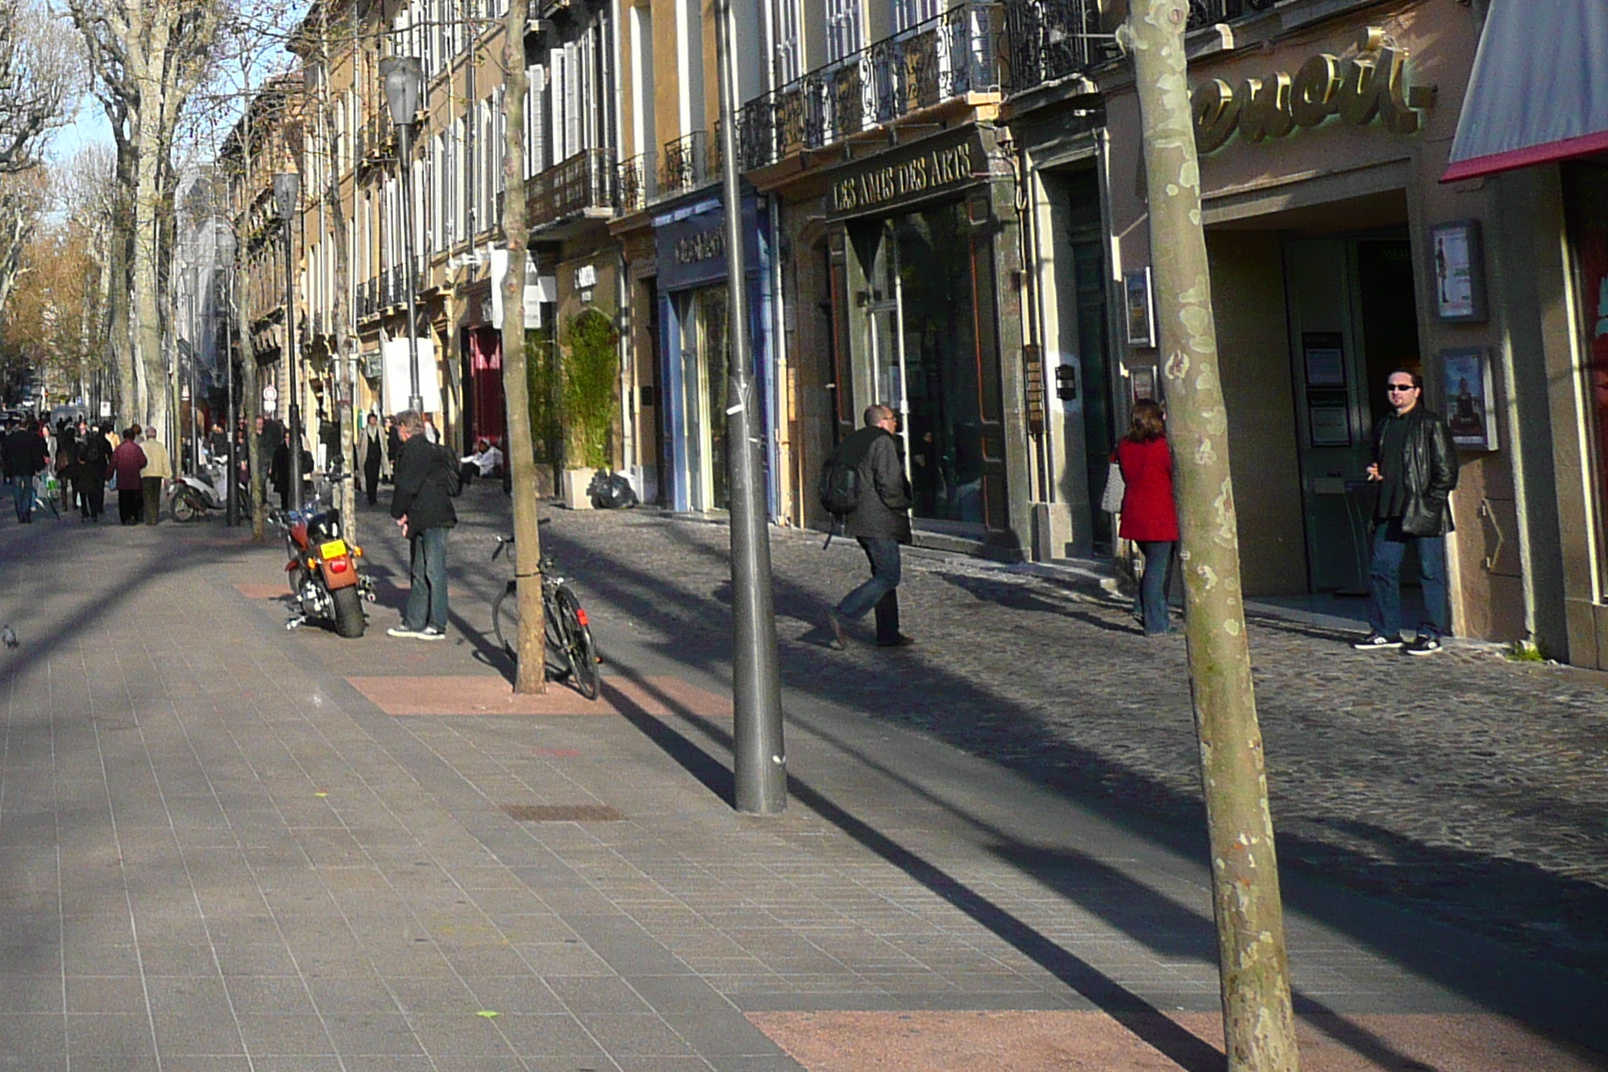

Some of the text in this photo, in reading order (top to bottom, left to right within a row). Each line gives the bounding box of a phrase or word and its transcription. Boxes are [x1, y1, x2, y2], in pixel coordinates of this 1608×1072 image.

[833, 142, 972, 210] LES AMIS DES ARTS
